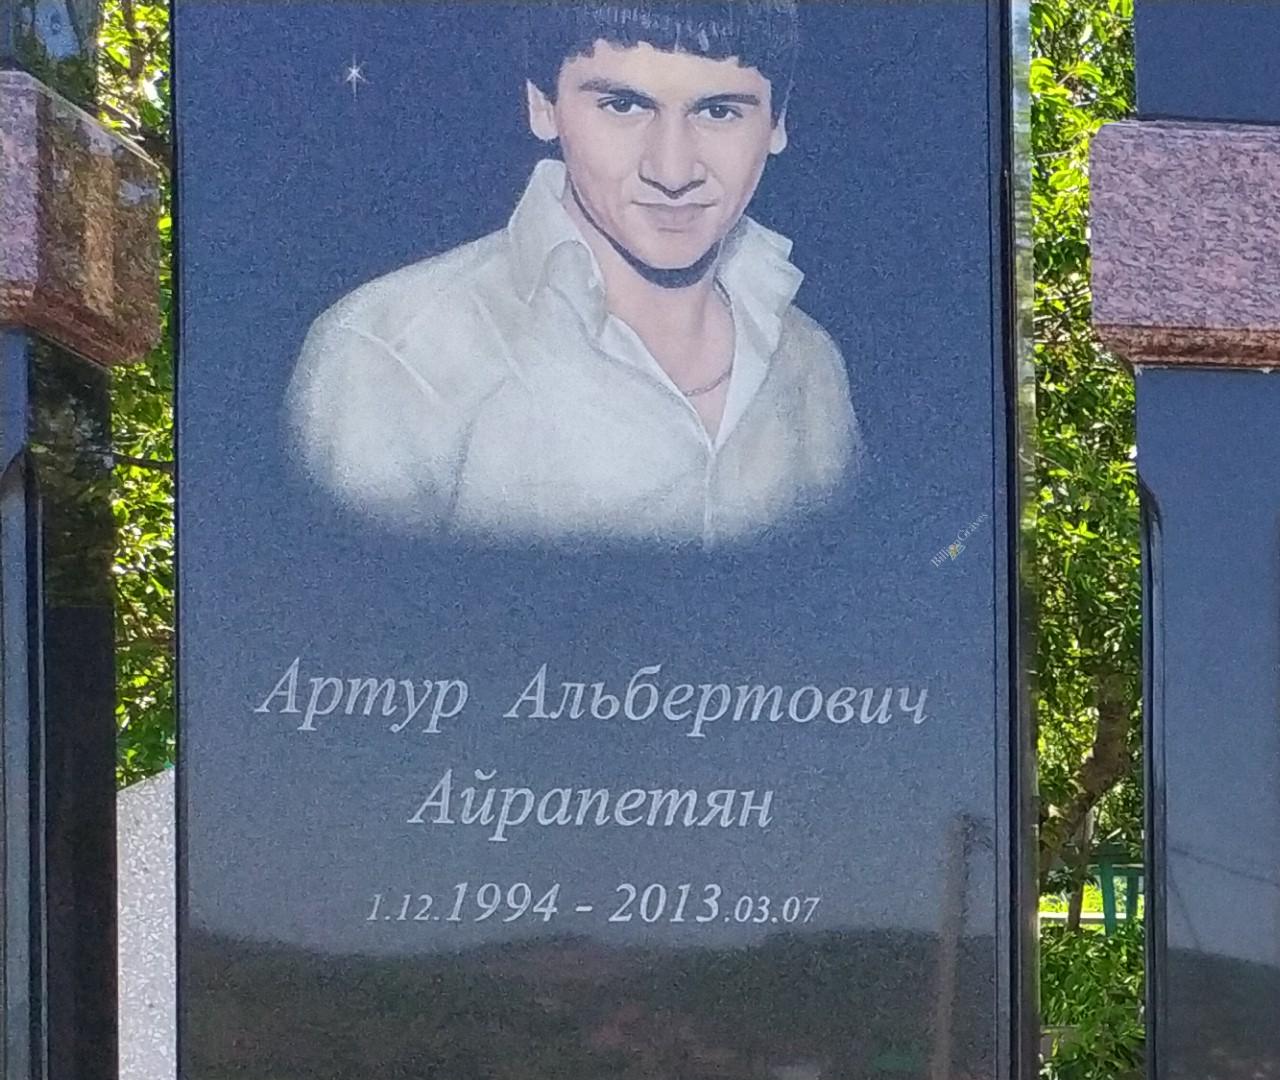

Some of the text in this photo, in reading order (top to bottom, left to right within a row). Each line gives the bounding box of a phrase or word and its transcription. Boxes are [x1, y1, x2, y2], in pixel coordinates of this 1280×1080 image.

[255, 657, 930, 737] Артур Альбертович
[408, 769, 774, 842] Айрапетян
[366, 883, 561, 924] 1.12.1994
[609, 883, 820, 924] 2013.03.07
